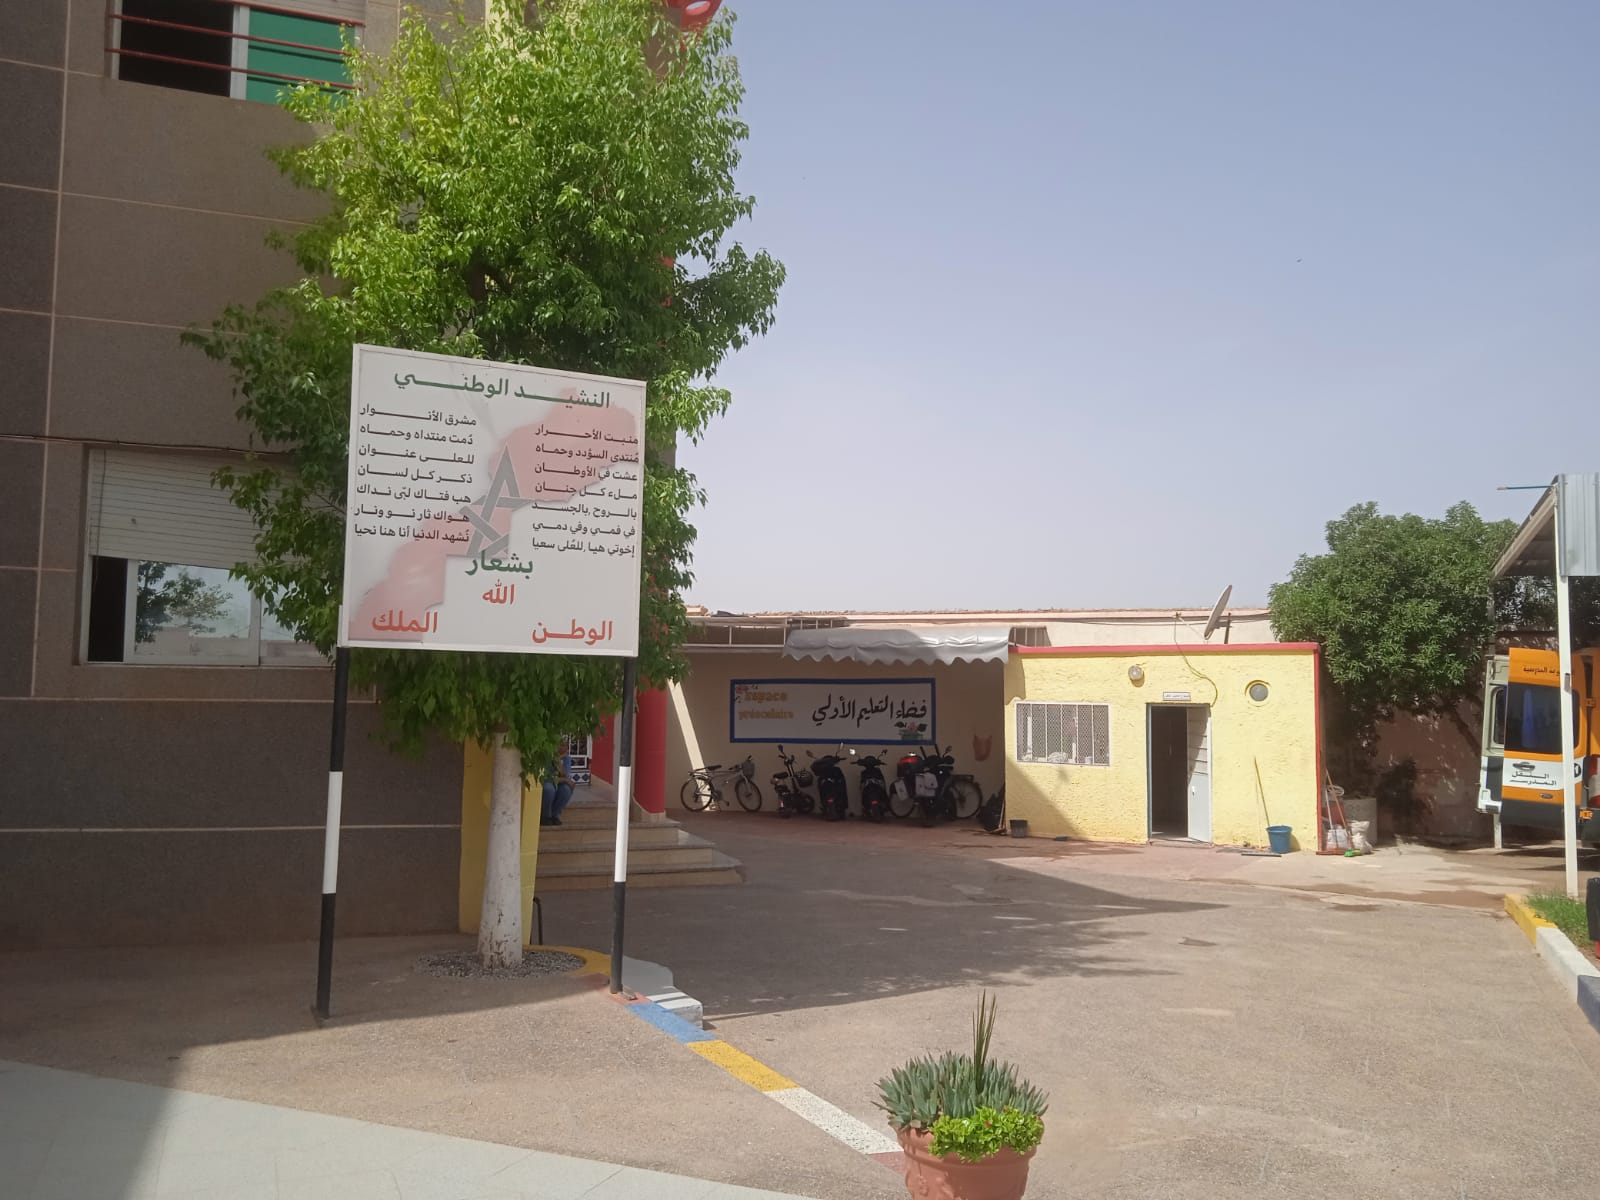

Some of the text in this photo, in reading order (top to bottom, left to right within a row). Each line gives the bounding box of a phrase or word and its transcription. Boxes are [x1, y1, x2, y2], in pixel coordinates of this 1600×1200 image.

[394, 372, 610, 408] النشيد الوطني
[359, 403, 477, 426] مشرق الأنوار
[359, 423, 412, 440] وحماه
[414, 429, 447, 442] منتداه
[535, 424, 639, 446] منبت الأحرار
[358, 443, 417, 458] عنوان
[535, 443, 574, 458] وحماه
[575, 448, 608, 460] السؤدد
[357, 463, 473, 484] ذكر كل لسان
[534, 462, 638, 481] عشت في الأوطان
[356, 483, 392, 496] نداك
[413, 488, 450, 501] فتاك
[535, 481, 638, 501] ملء كل جنان
[452, 495, 472, 505] هب
[353, 503, 384, 518] ونار
[416, 508, 432, 521] ثار
[433, 510, 470, 523] هواك
[592, 506, 637, 520] بالروح
[354, 523, 377, 537] نحيا
[379, 525, 396, 537] هنا
[398, 525, 411, 538] أنا
[412, 528, 440, 542] الدنيا
[532, 521, 636, 538] في فمي وفي دمي
[532, 537, 556, 550] سعيا
[588, 542, 606, 555] هيا
[464, 550, 535, 580] بشعار
[481, 579, 516, 605] الله
[371, 609, 439, 633] الملك
[531, 618, 614, 646] الوطن
[811, 693, 928, 728] فضاء التعليم الأولي
